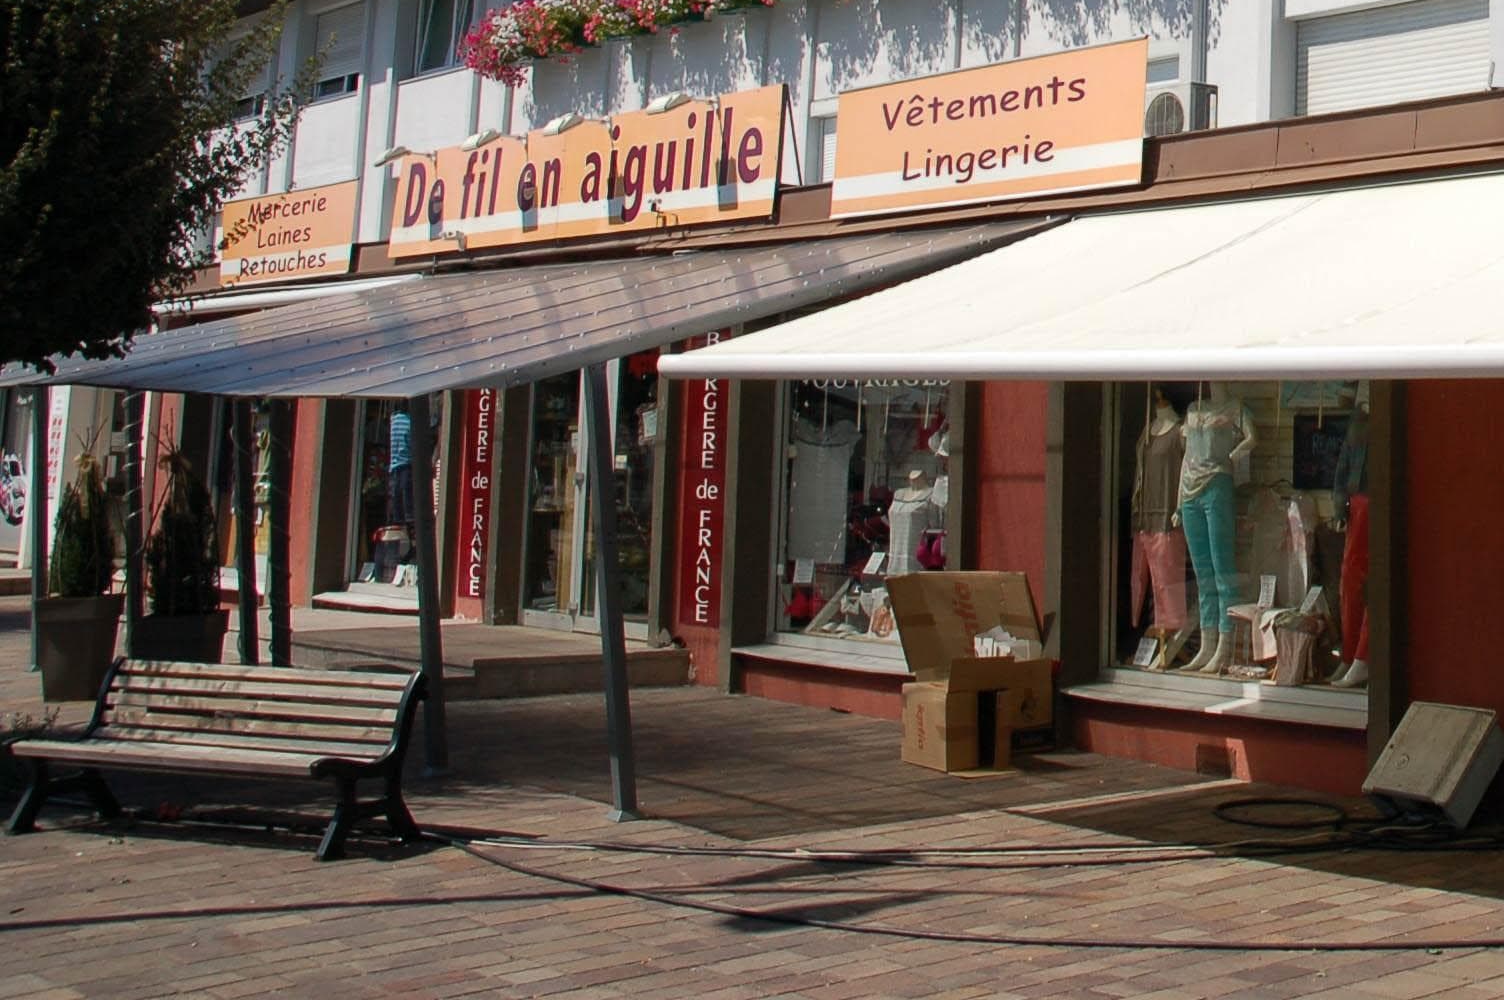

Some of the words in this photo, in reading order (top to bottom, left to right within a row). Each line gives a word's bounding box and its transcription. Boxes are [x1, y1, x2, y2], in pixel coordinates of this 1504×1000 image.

[883, 76, 1086, 131] Vêtements
[403, 163, 444, 228] De
[461, 147, 503, 220] fil
[517, 156, 562, 213] en
[580, 107, 764, 222] aiguille
[902, 134, 1055, 184] Lingerie
[248, 193, 327, 223] Mercerie
[257, 226, 312, 249] Laines
[239, 250, 327, 278] Retouches
[701, 332, 720, 469] BRGERE
[471, 471, 489, 490] de
[695, 479, 719, 500] de
[469, 499, 484, 597] FRANCE
[695, 510, 712, 623] FRANCE
